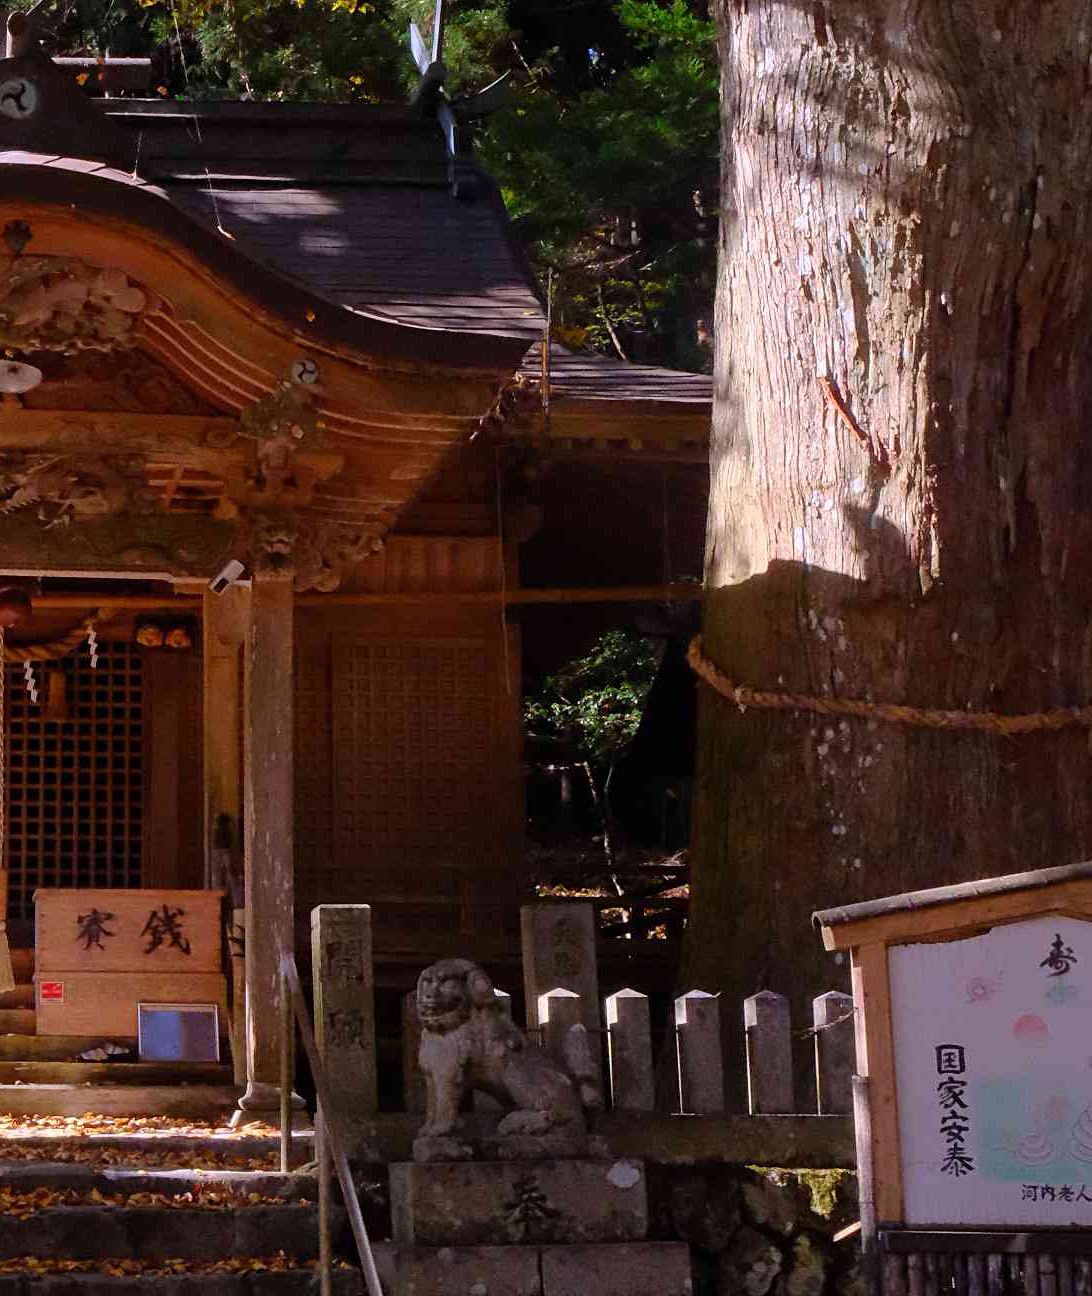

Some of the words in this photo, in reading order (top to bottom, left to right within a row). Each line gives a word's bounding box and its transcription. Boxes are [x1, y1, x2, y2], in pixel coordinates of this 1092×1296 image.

[1040, 934, 1078, 978] 寿
[935, 1044, 975, 1178] 国家安泰
[1020, 1184, 1092, 1202] 河内老人
